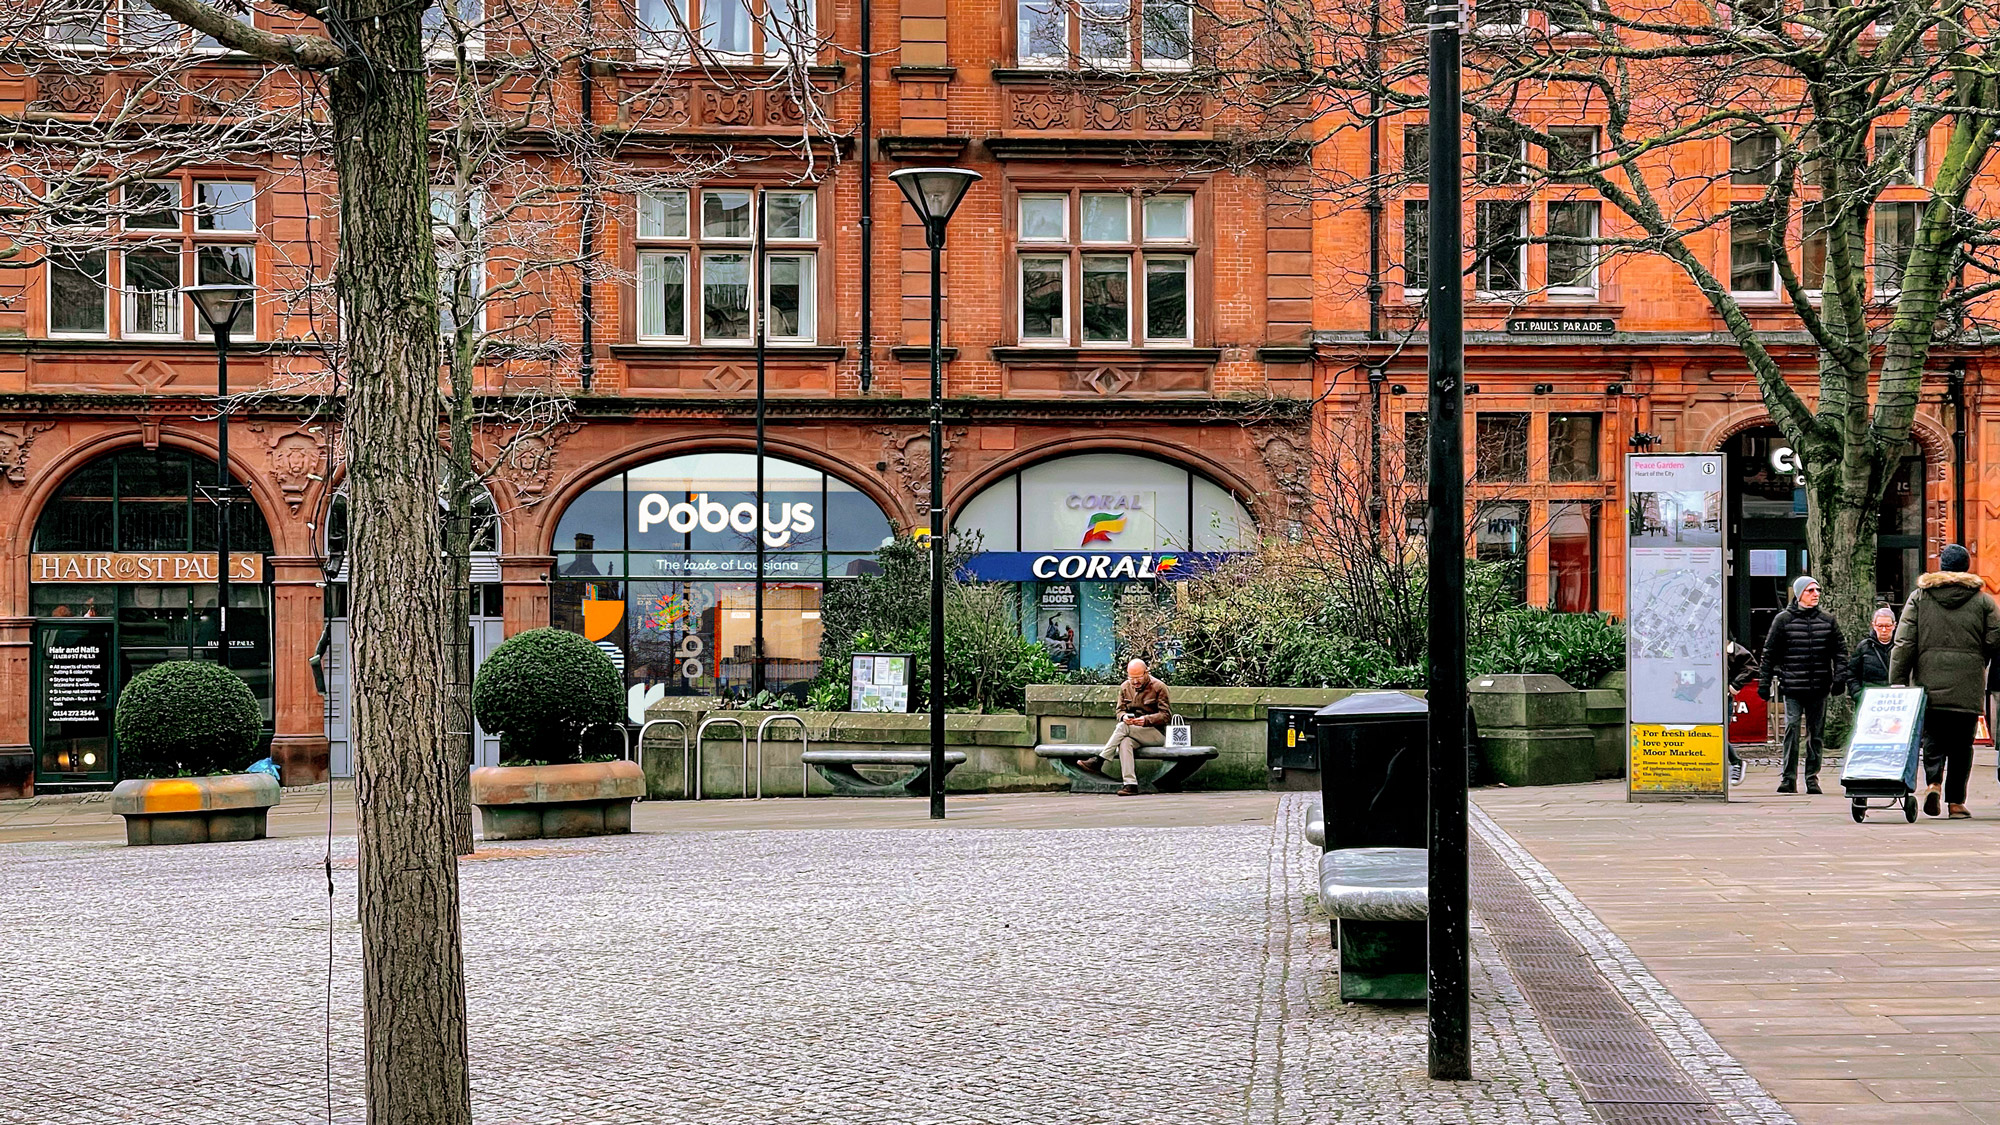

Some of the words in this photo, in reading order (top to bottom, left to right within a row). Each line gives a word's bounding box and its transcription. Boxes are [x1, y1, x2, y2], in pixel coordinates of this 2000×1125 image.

[1514, 321, 1528, 331] ST.
[1530, 321, 1559, 331] PAUL'S
[1563, 321, 1603, 331] PARADE
[1635, 461, 1656, 469] Peace
[1656, 461, 1685, 470] Gardens
[1066, 494, 1142, 510] CORAL
[656, 560, 680, 570] The
[683, 559, 719, 570] taste
[721, 560, 734, 570] of
[737, 560, 799, 570] Lousiana
[1032, 555, 1156, 579] CORAL
[1045, 585, 1072, 594] ACCA
[1123, 585, 1150, 594] ACCA
[1042, 595, 1075, 604] BOOST
[1662, 730, 1685, 738] fresh
[1670, 749, 1706, 757] Market.
